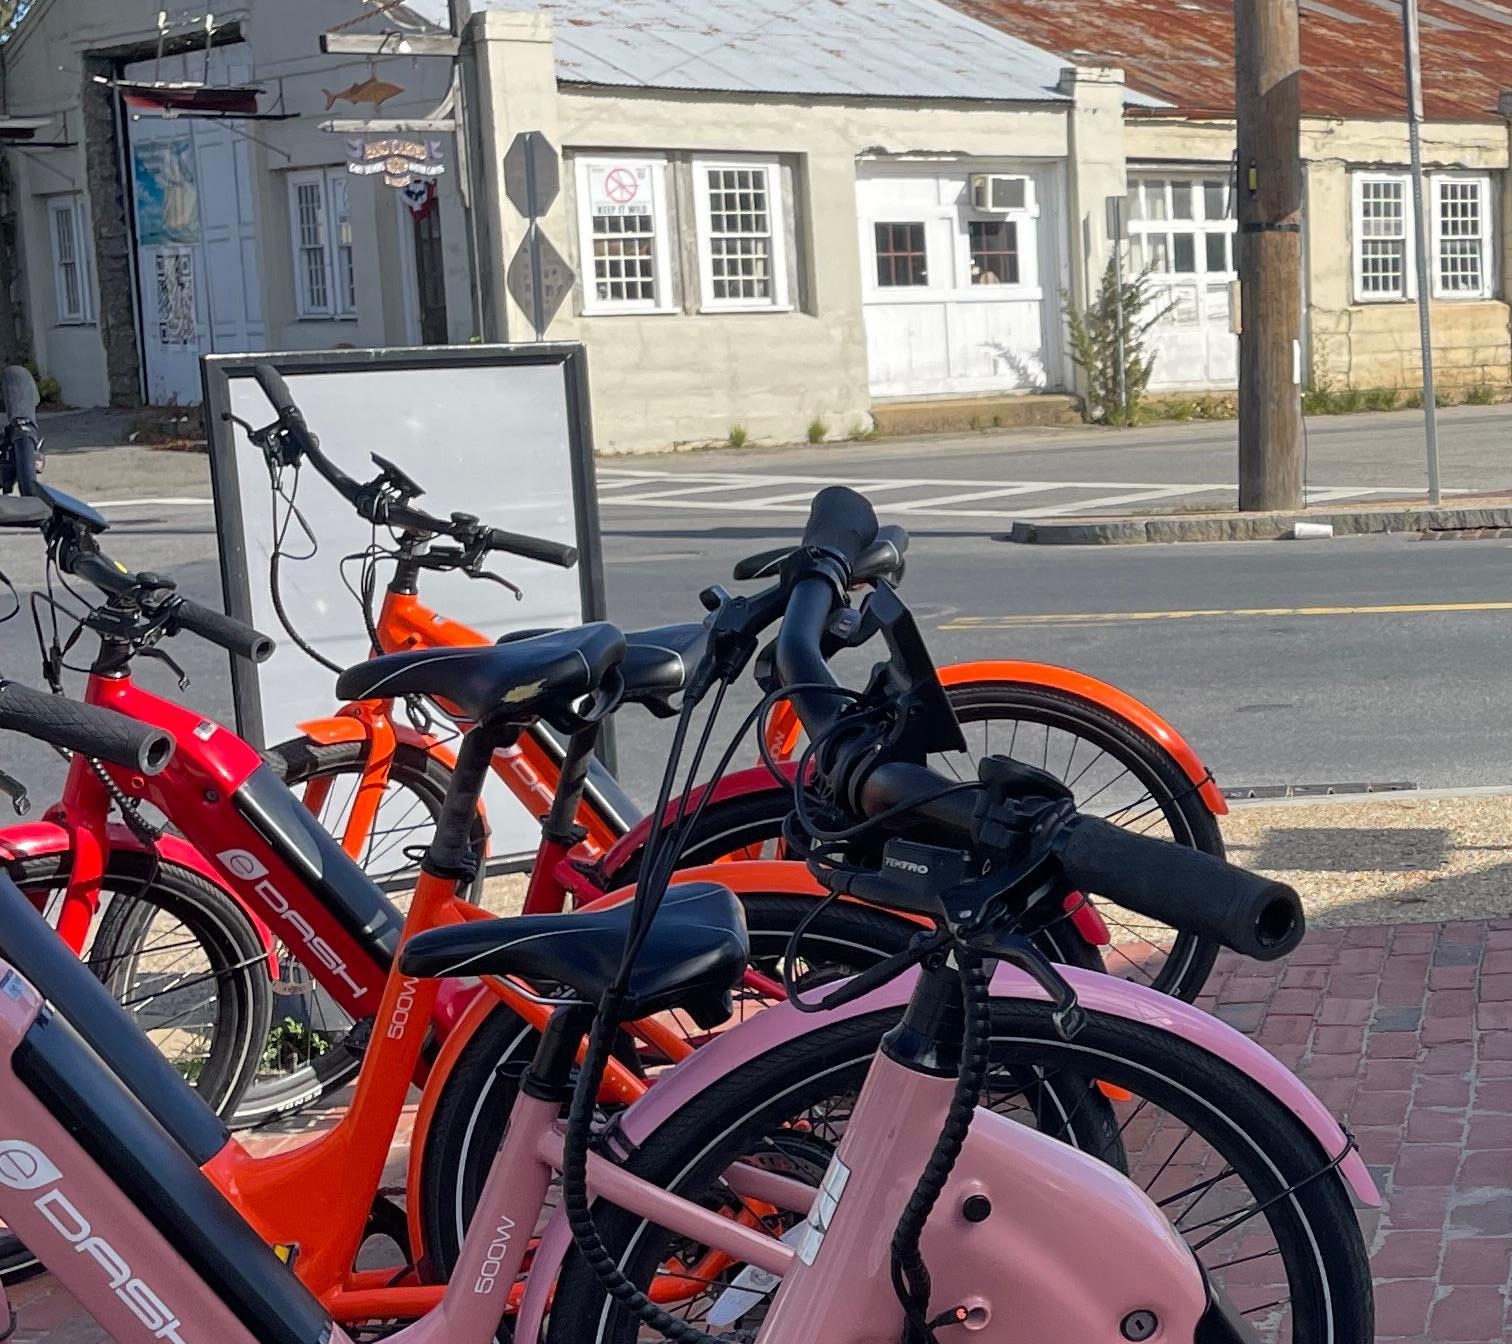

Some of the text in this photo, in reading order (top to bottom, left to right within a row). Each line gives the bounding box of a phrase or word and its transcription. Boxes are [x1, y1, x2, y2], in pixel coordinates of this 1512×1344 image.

[885, 857, 929, 874] TEKTRO
[254, 880, 369, 999] DASH
[387, 977, 419, 1040] 500W
[474, 1215, 516, 1294] 500W
